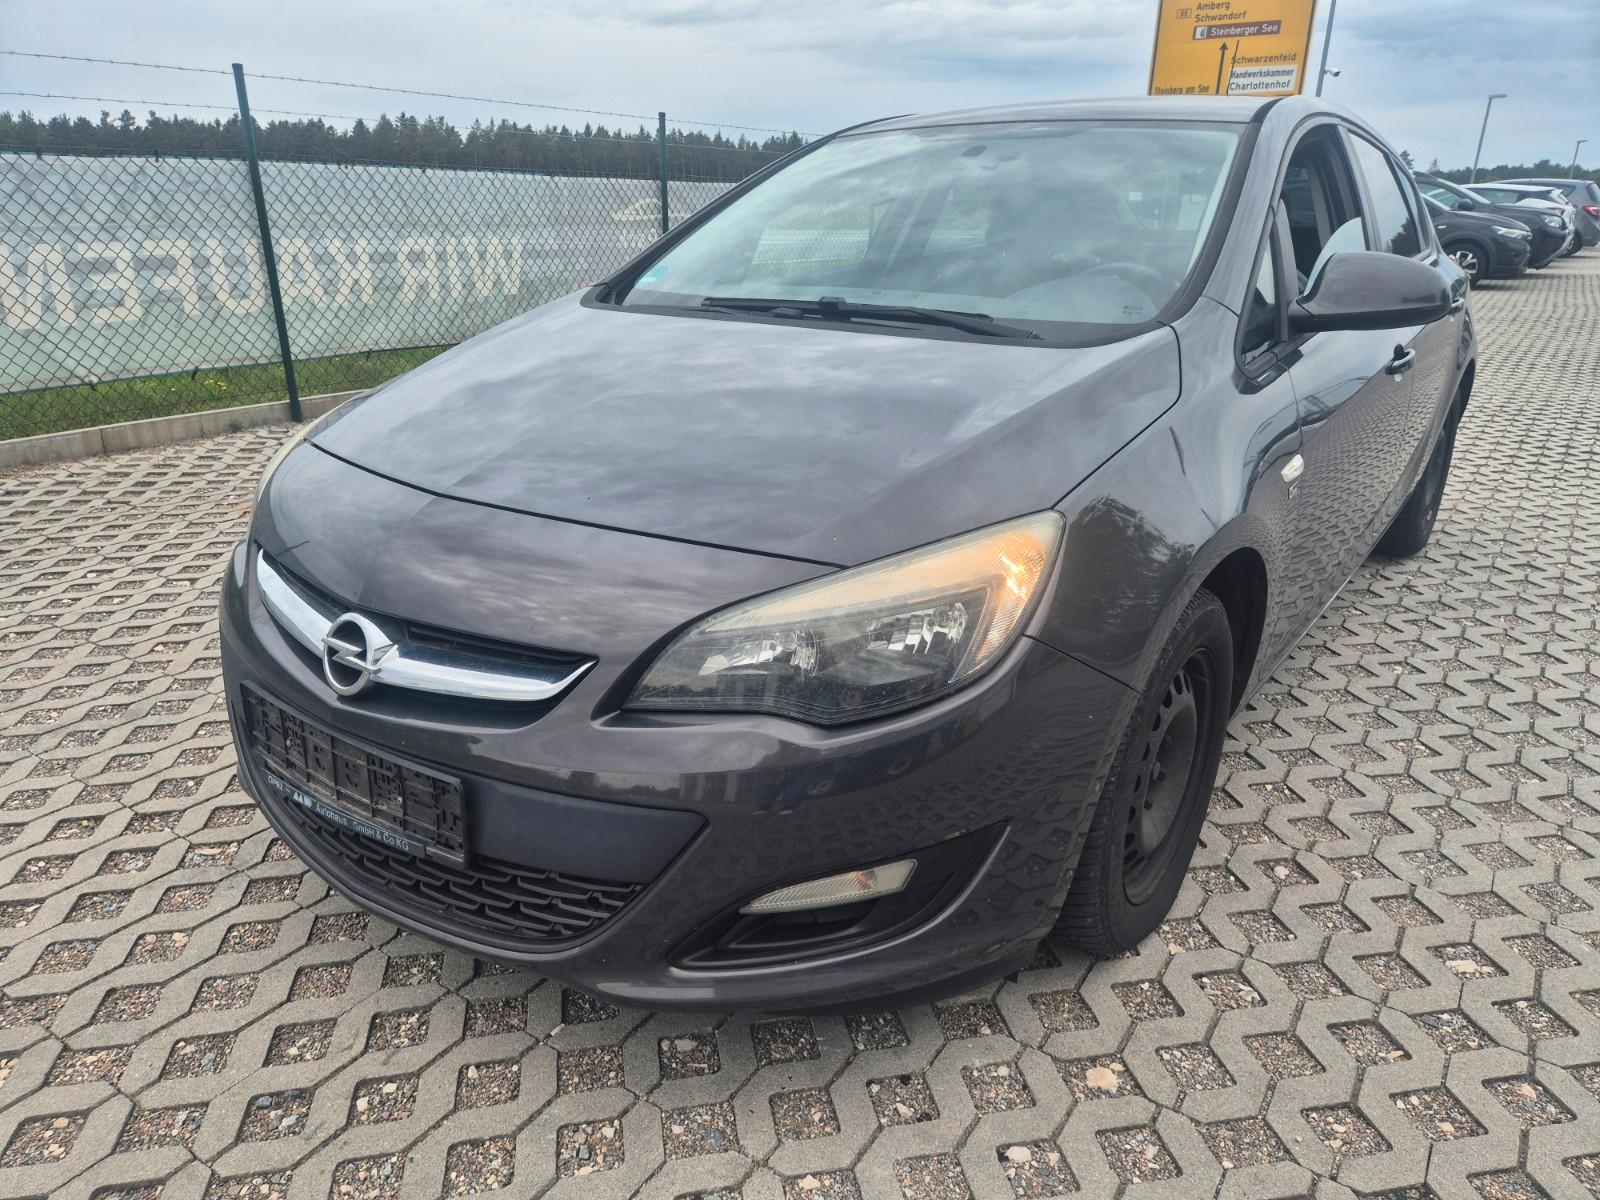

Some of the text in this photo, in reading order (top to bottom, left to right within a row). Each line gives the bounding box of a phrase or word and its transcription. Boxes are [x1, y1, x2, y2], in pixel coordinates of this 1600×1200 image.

[1196, 1, 1231, 11] Amberg
[1195, 10, 1247, 23] Schwandorf
[1211, 23, 1279, 37] Steinberger See
[1231, 53, 1297, 64] Schwarzenfeld
[1231, 69, 1295, 79] Handwerkskammer
[1229, 80, 1291, 91] Charlottenhof
[352, 820, 375, 838] GmbH
[396, 838, 409, 851] KG
